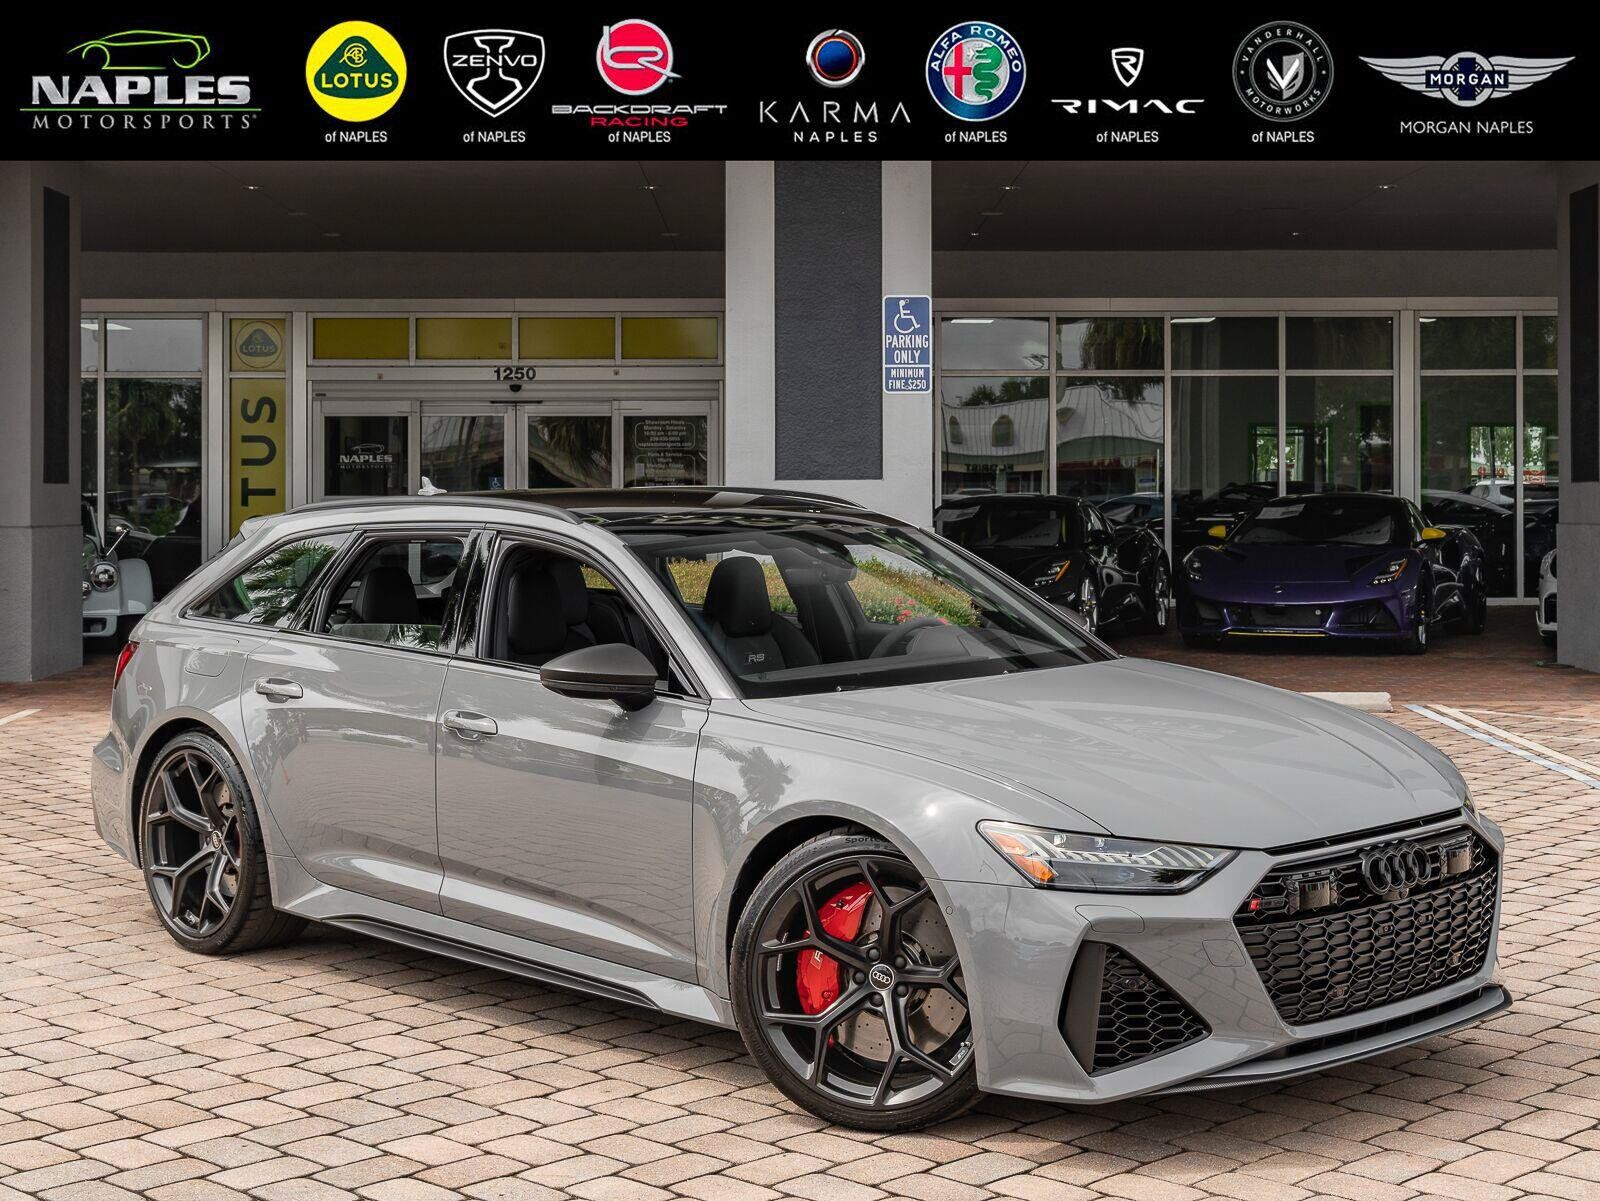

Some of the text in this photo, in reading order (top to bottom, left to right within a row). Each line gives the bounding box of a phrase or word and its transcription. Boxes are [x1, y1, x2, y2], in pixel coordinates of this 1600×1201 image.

[886, 334, 929, 349] PARKING
[242, 344, 275, 354] LOTUS
[894, 350, 920, 364] ONLY
[493, 366, 536, 381] 1250
[891, 368, 924, 378] MINIMUM
[888, 379, 927, 390] FINE $250
[240, 396, 277, 512] TUS
[340, 455, 393, 463] NAPLES
